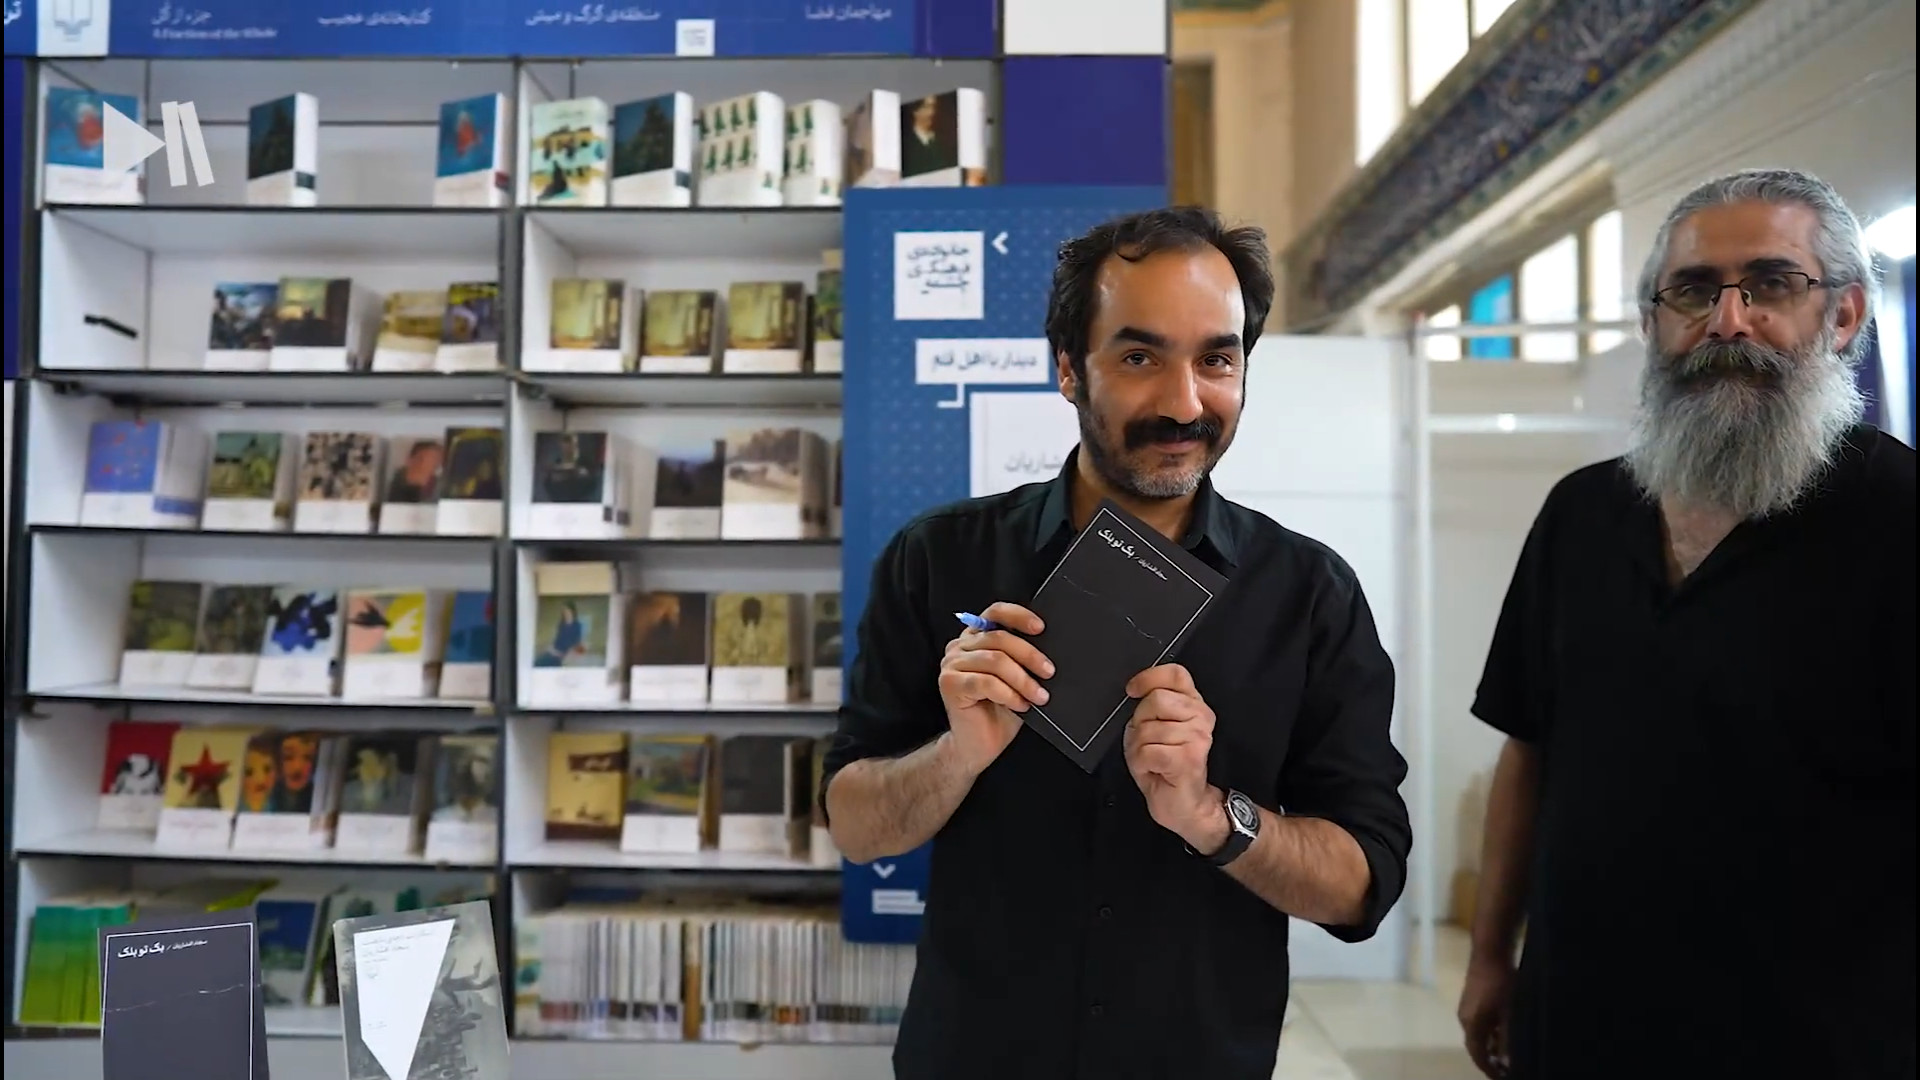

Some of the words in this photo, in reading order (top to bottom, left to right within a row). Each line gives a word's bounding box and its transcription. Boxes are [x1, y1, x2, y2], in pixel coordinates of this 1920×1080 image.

[931, 349, 956, 374] قلم
[1000, 350, 1038, 371] دیدار
[1004, 450, 1064, 476] شاریان
